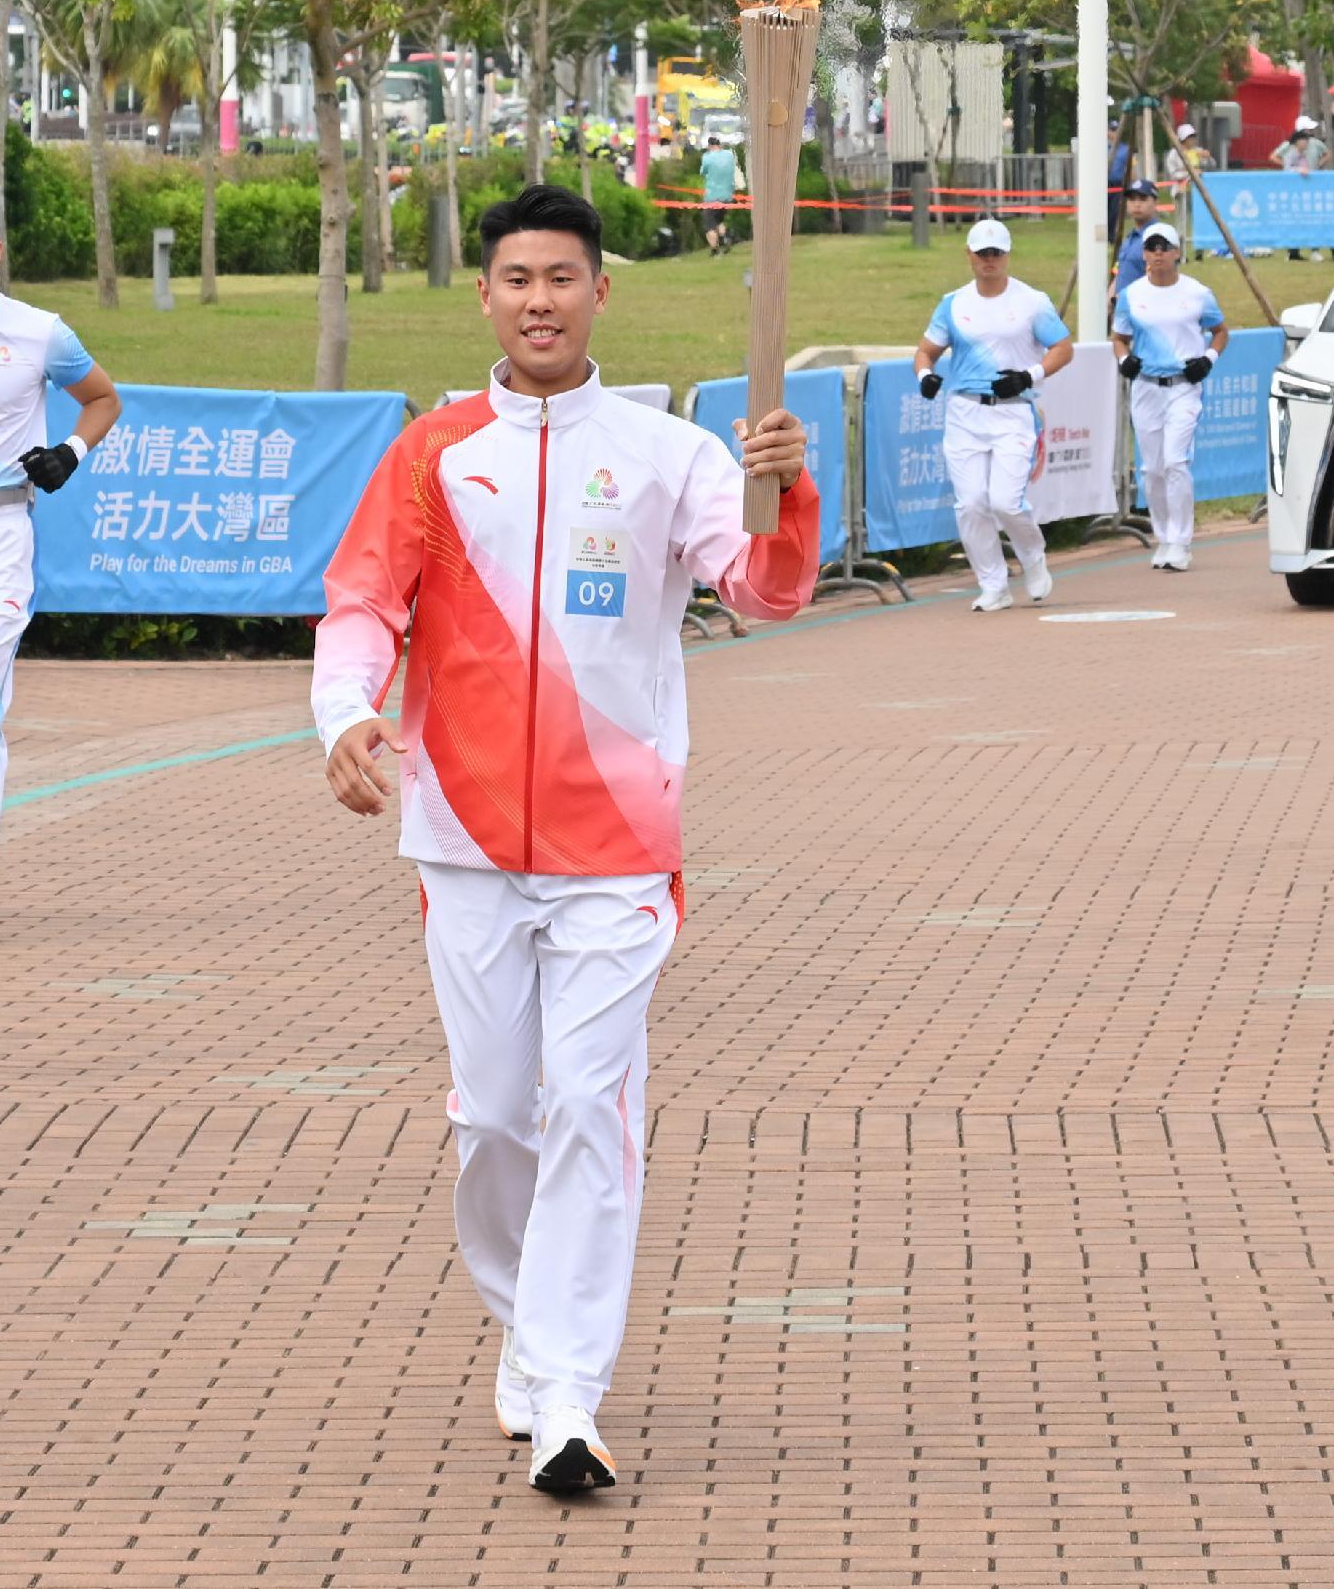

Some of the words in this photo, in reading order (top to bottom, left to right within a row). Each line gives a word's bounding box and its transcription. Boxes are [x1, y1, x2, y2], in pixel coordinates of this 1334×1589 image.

[90, 424, 296, 480] 激情全運會
[90, 490, 296, 542] 活力大灣區
[90, 553, 123, 575] Play
[127, 553, 153, 573] for
[153, 554, 177, 573] the
[179, 555, 237, 574] Dreams
[241, 555, 256, 573] in
[259, 556, 293, 574] GBA
[578, 581, 615, 607] 09
